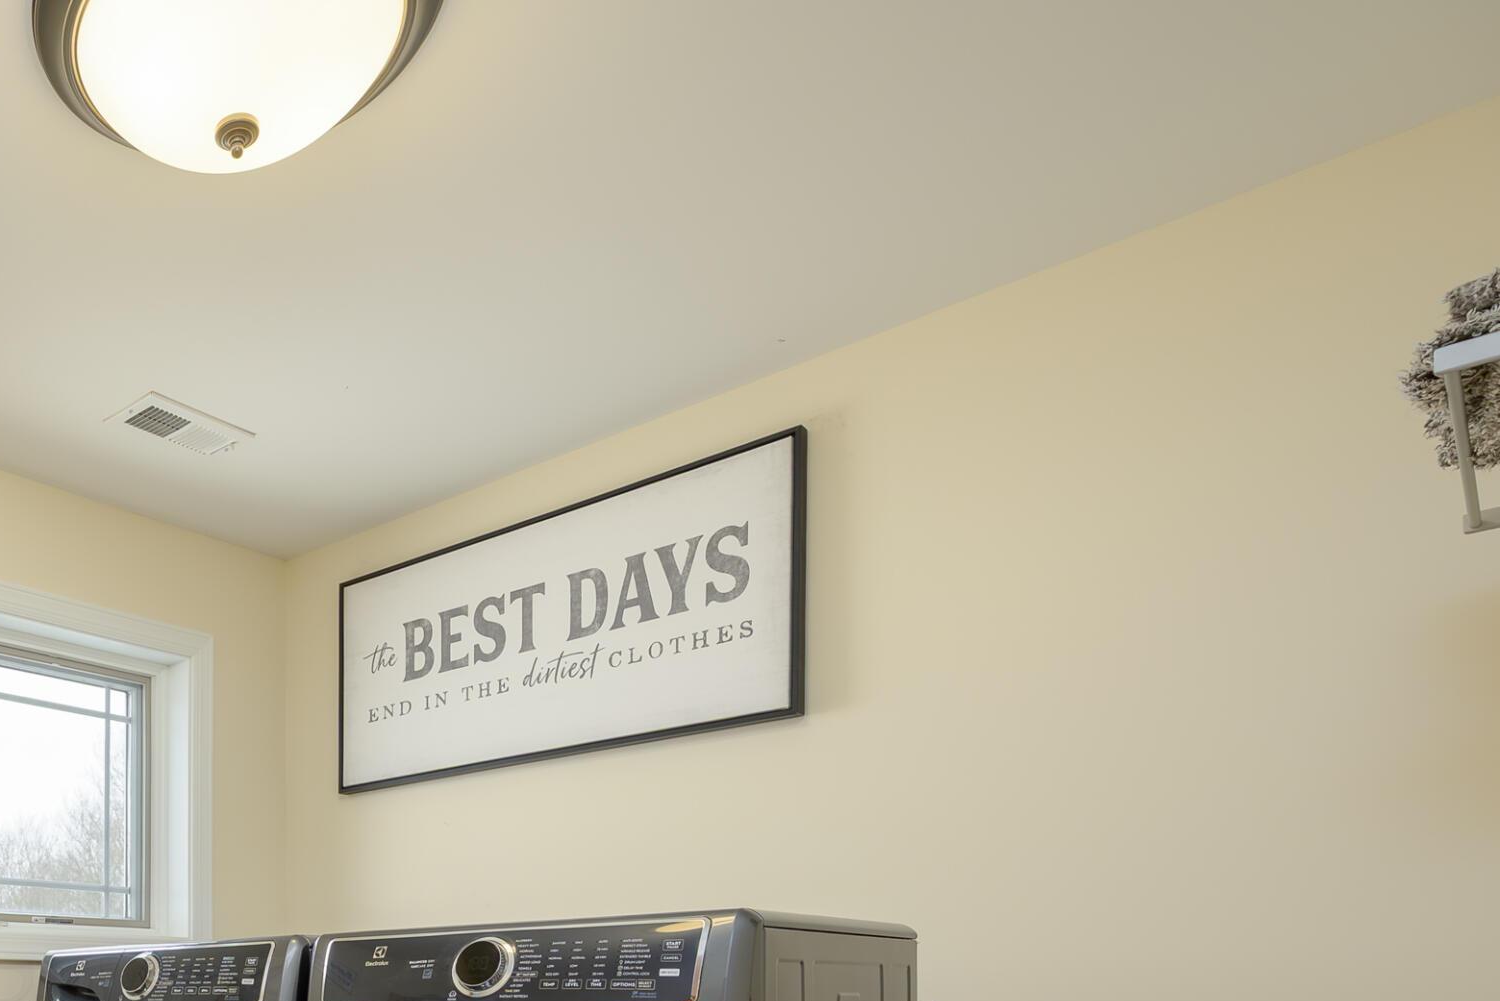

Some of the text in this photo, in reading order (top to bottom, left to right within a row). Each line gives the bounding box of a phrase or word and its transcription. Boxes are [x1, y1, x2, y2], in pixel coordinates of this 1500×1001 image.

[363, 520, 751, 682] the BEST DAYS
[367, 619, 755, 724] END IN THE dirtiest CLOTHES
